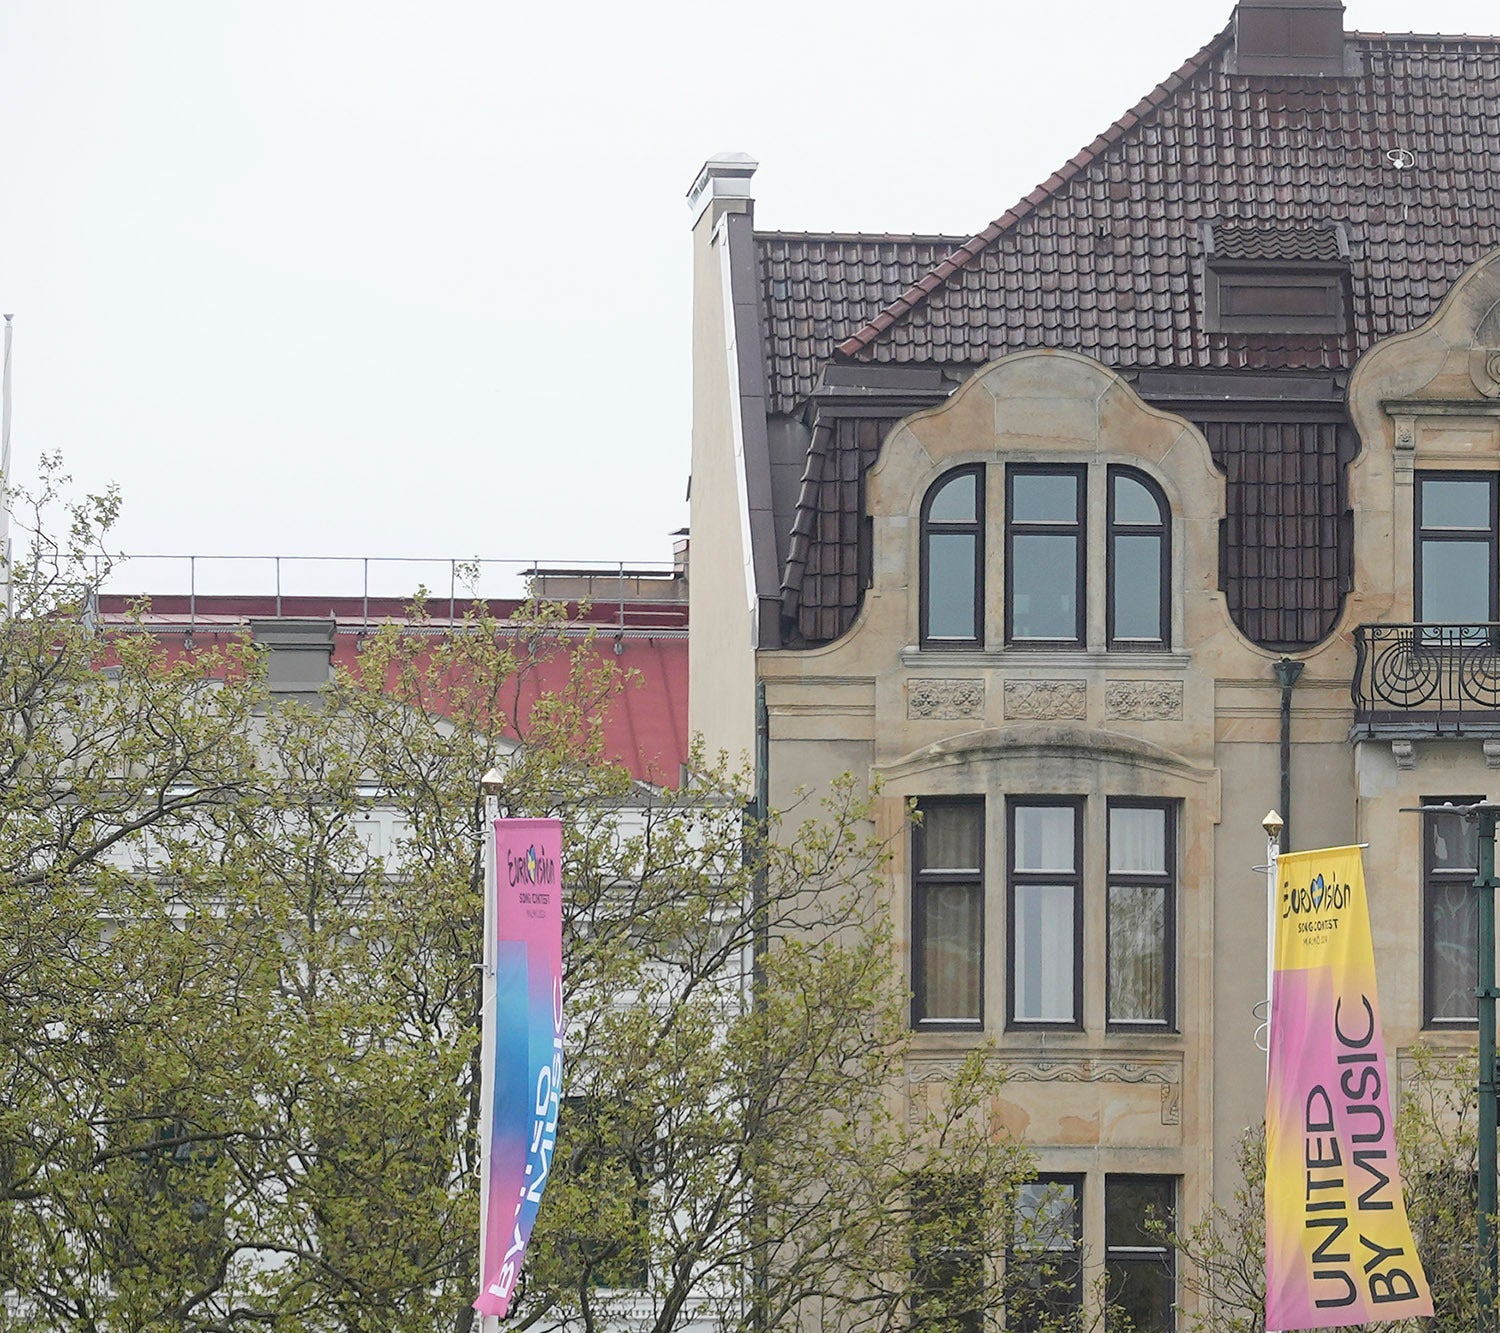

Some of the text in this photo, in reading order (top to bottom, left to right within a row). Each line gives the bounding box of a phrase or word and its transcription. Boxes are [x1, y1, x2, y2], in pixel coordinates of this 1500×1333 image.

[1305, 1084, 1358, 1309] UNITED
[1335, 994, 1420, 1305] BY MUSIC
